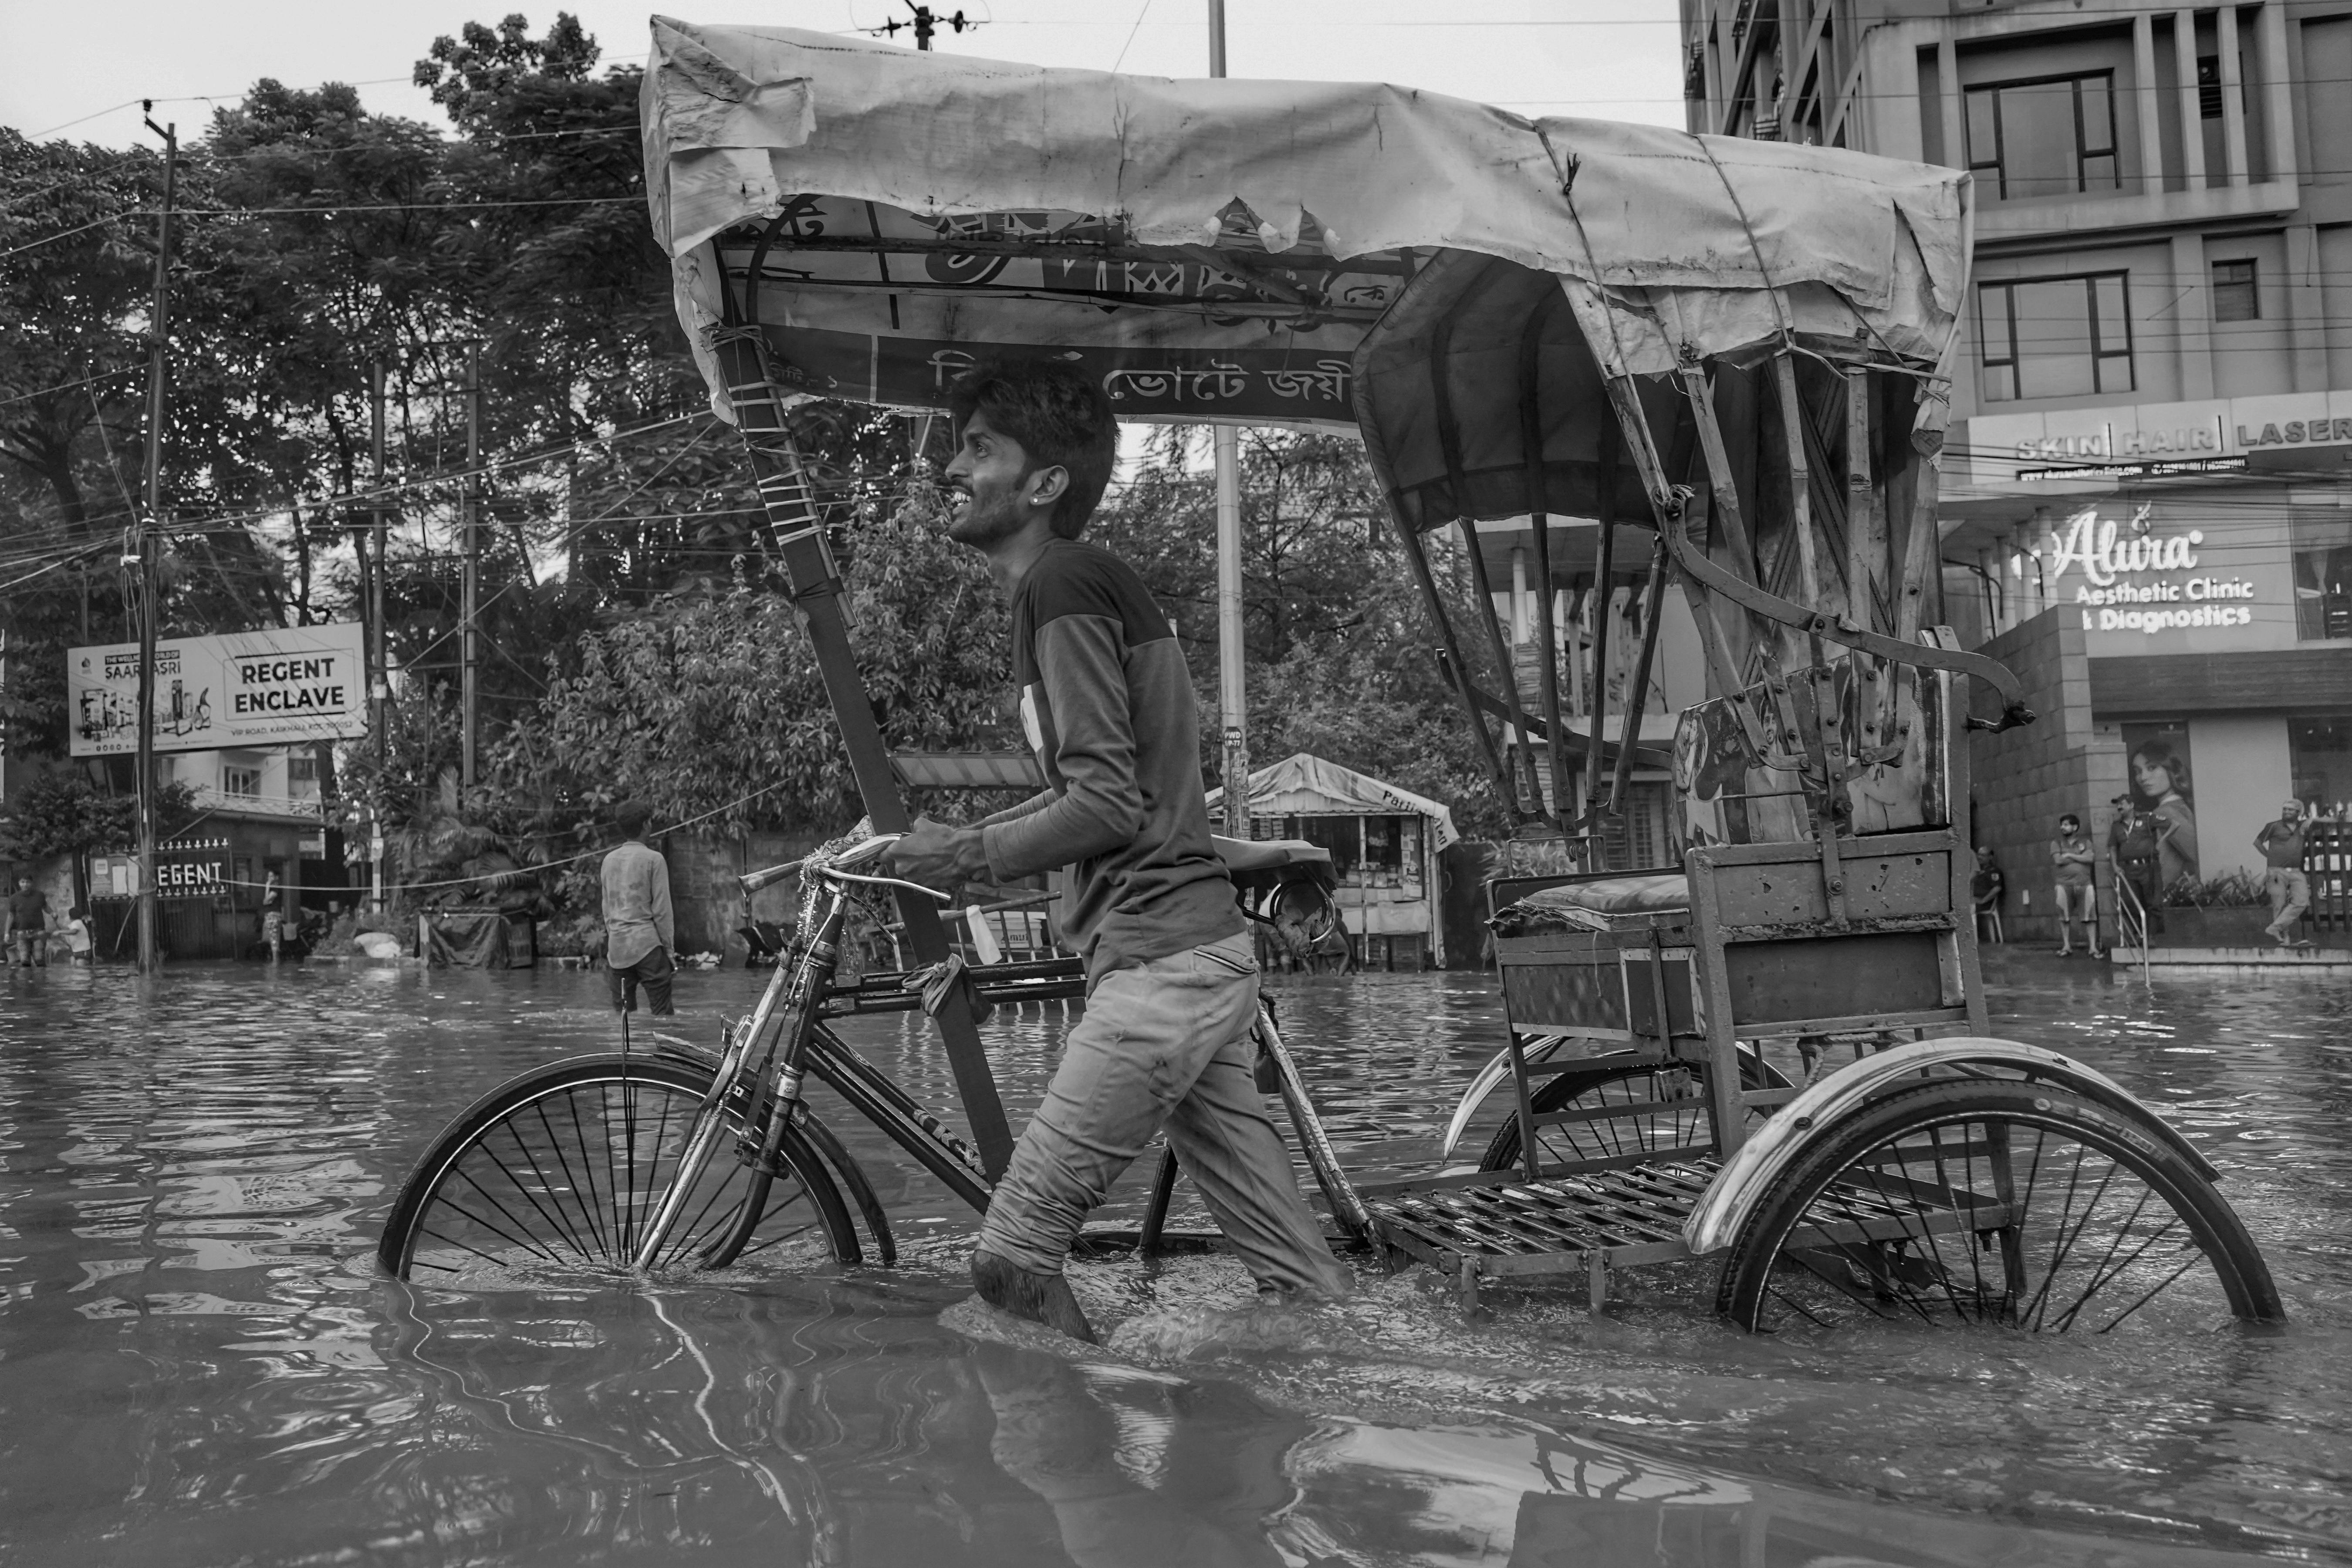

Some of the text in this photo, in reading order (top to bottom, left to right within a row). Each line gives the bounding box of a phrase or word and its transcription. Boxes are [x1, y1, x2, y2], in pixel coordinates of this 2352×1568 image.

[1102, 358, 1352, 402] ভোটে জয়ী
[2016, 418, 2352, 460] SKIN HAIR LASER
[2076, 577, 2254, 605] Aesthetic Clinic
[2099, 605, 2251, 634] Diagnostics
[105, 661, 181, 679] SAARASRI
[242, 658, 335, 684] REGENT
[235, 686, 344, 713] ENCLAVE
[157, 862, 222, 886] EGENT
